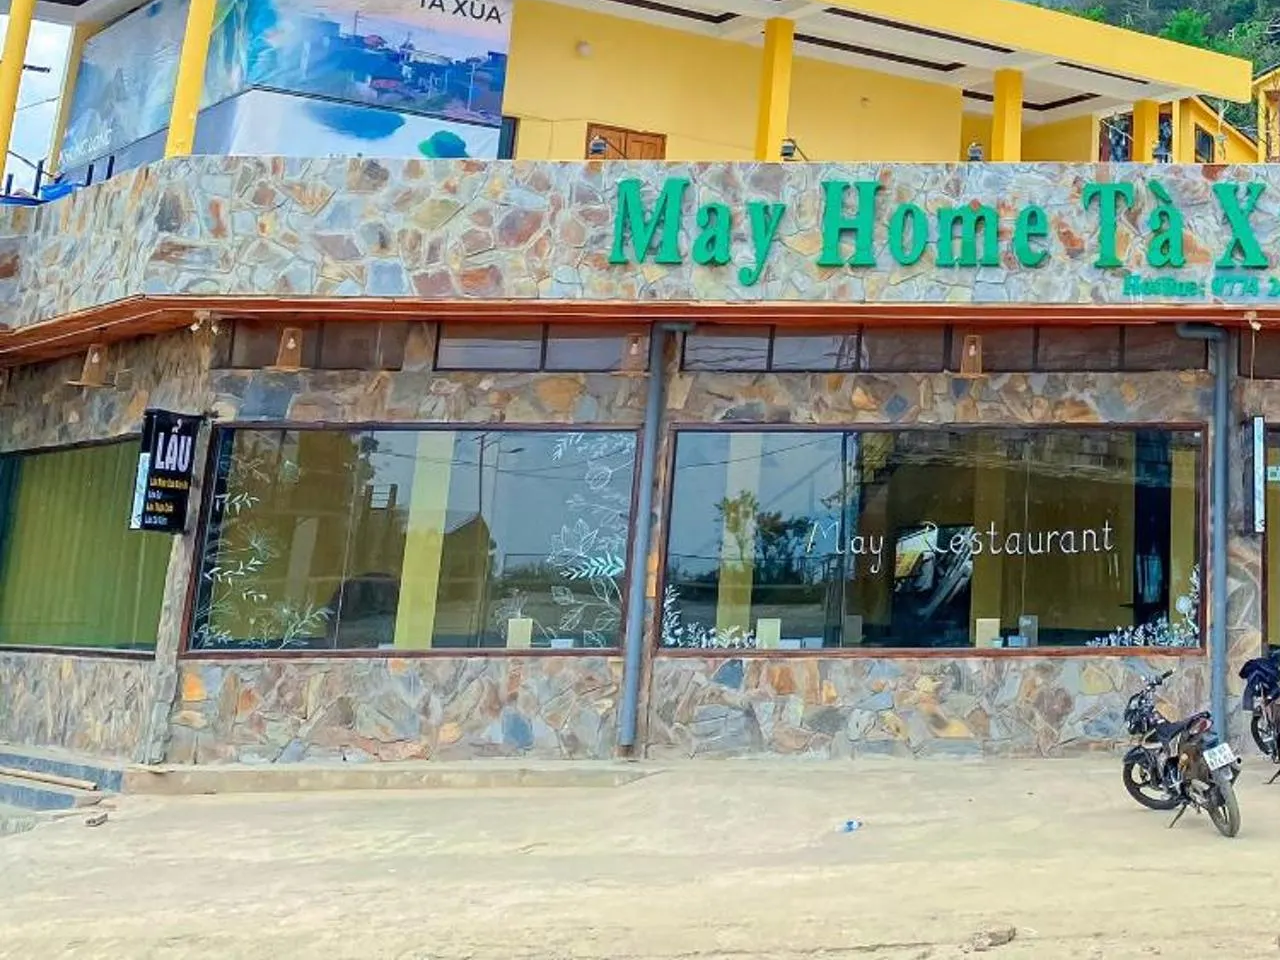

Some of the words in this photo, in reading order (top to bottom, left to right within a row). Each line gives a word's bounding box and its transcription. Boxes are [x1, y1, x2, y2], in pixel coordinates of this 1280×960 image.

[609, 177, 785, 286] May
[817, 180, 1049, 268] Home
[1084, 179, 1186, 270] Tà
[804, 520, 884, 573] May
[918, 519, 1114, 554] Restaurant
